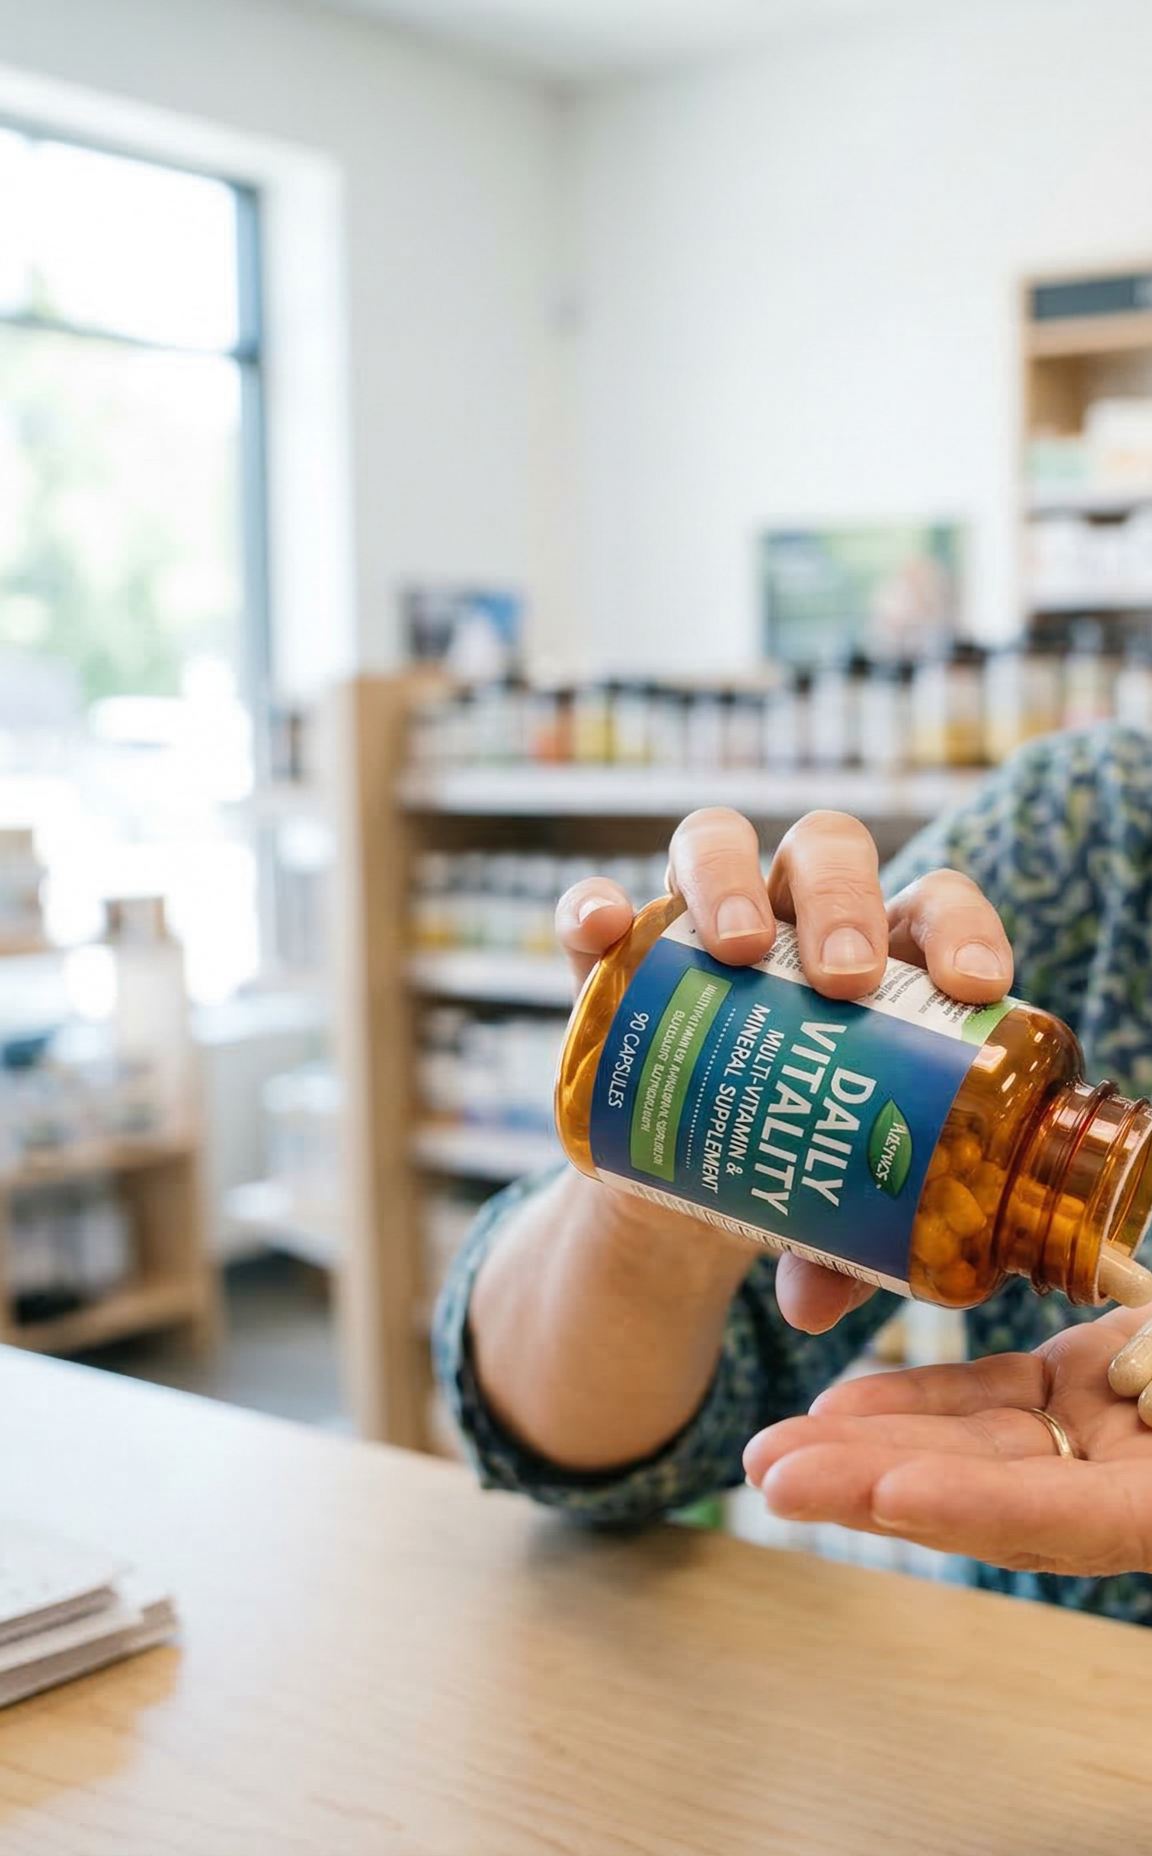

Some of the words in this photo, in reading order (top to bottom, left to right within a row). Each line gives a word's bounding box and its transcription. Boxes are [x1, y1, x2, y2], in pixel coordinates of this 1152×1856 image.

[629, 1012, 650, 1031] 90
[723, 1003, 772, 1077] MINERAL
[608, 1033, 640, 1109] CAPSULES
[727, 1028, 785, 1161] MULTI-VITAMIN
[701, 1083, 737, 1194] SUPPLEMENT
[751, 1021, 848, 1216] VITALITY
[801, 1066, 877, 1207] DAILY
[725, 1162, 744, 1176] &
